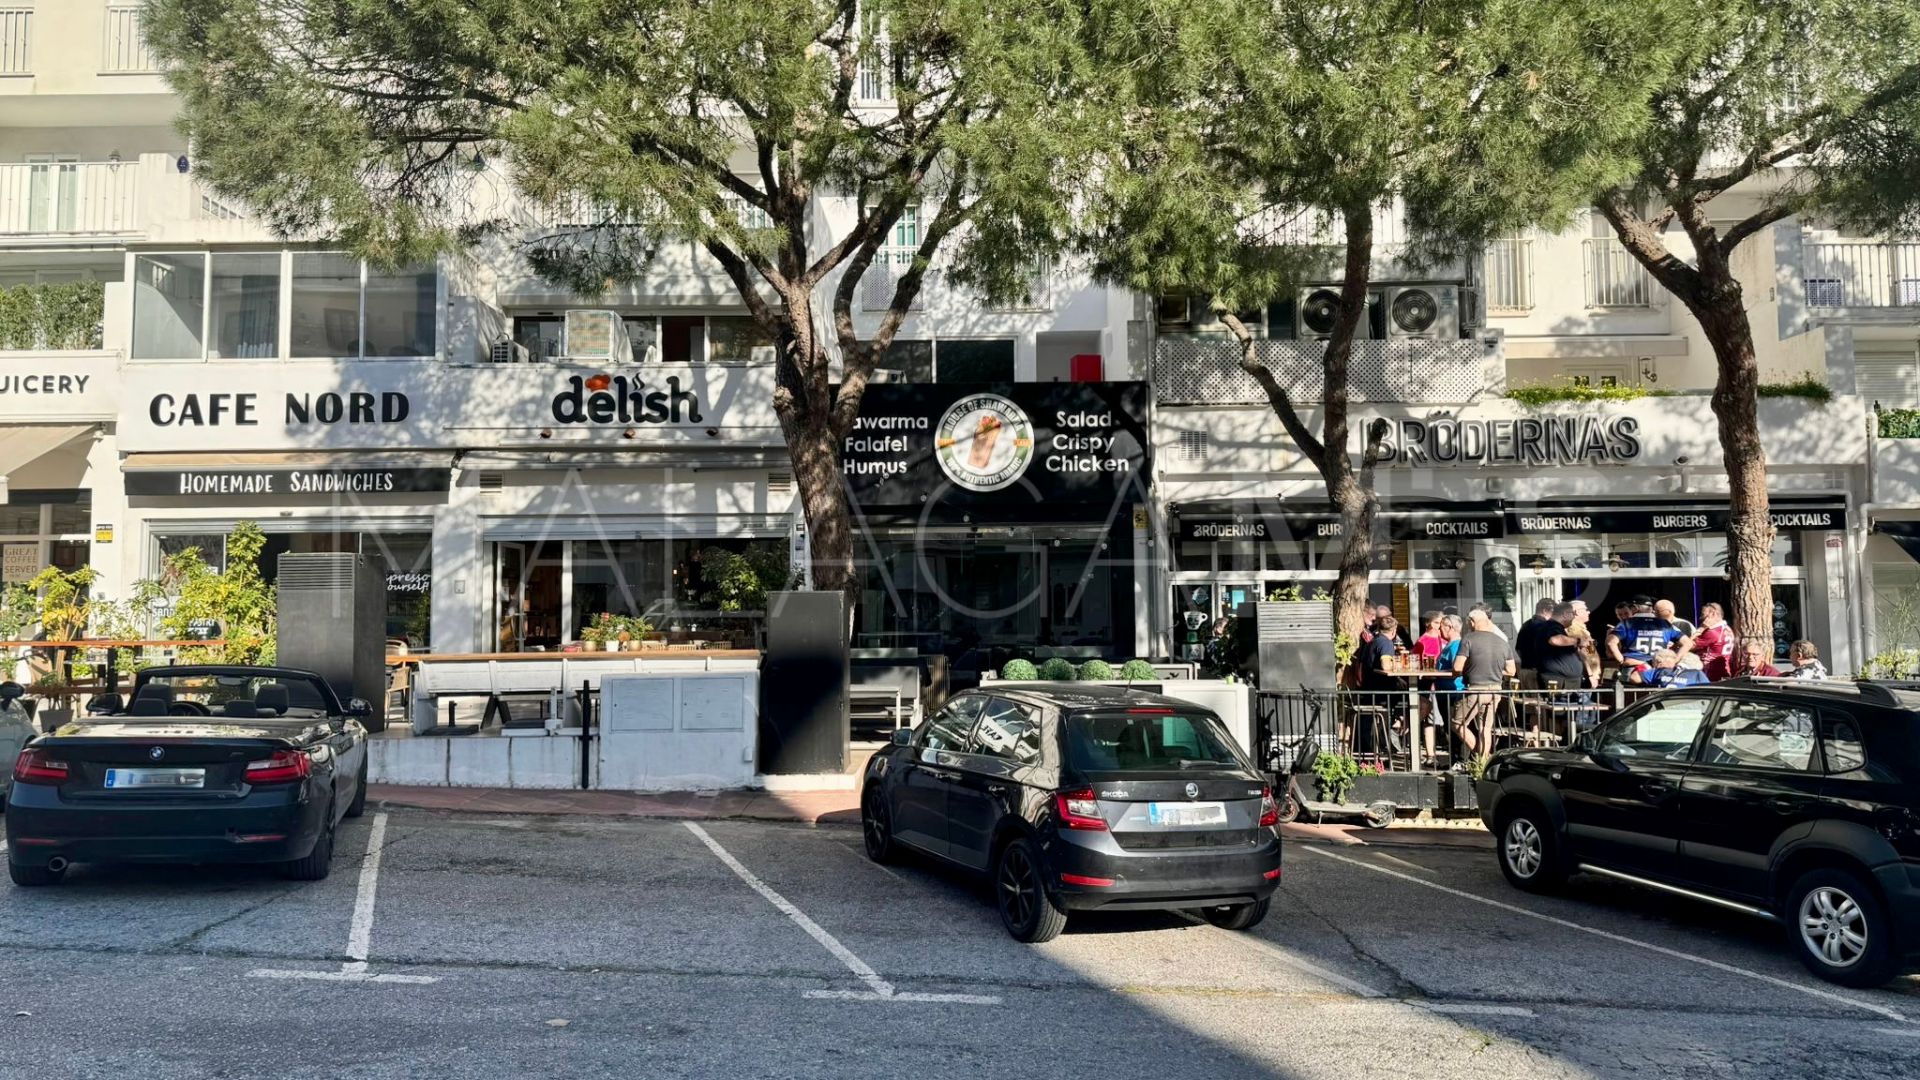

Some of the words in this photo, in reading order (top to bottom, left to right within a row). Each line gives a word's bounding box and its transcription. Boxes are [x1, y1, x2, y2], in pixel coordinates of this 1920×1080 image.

[0, 375, 90, 394] UICERY
[552, 373, 703, 424] delish
[149, 392, 259, 426] CAFE
[285, 391, 411, 424] NORD
[944, 406, 969, 431] HOUSE
[968, 399, 980, 412] OF
[853, 416, 928, 430] awarma
[1056, 410, 1112, 428] Salad
[845, 435, 908, 453] Falafel
[1052, 433, 1116, 454] Crispy
[843, 459, 908, 474] Humus
[1045, 455, 1130, 472] Chicken
[960, 472, 1001, 485] AUTHENTIC
[1426, 521, 1489, 535] COCKTAILS
[1521, 515, 1592, 530] BRÖDERNAS
[1653, 515, 1708, 529] BURGERS
[1770, 513, 1831, 526] COCKTAILS
[4, 565, 38, 573] SERVED
